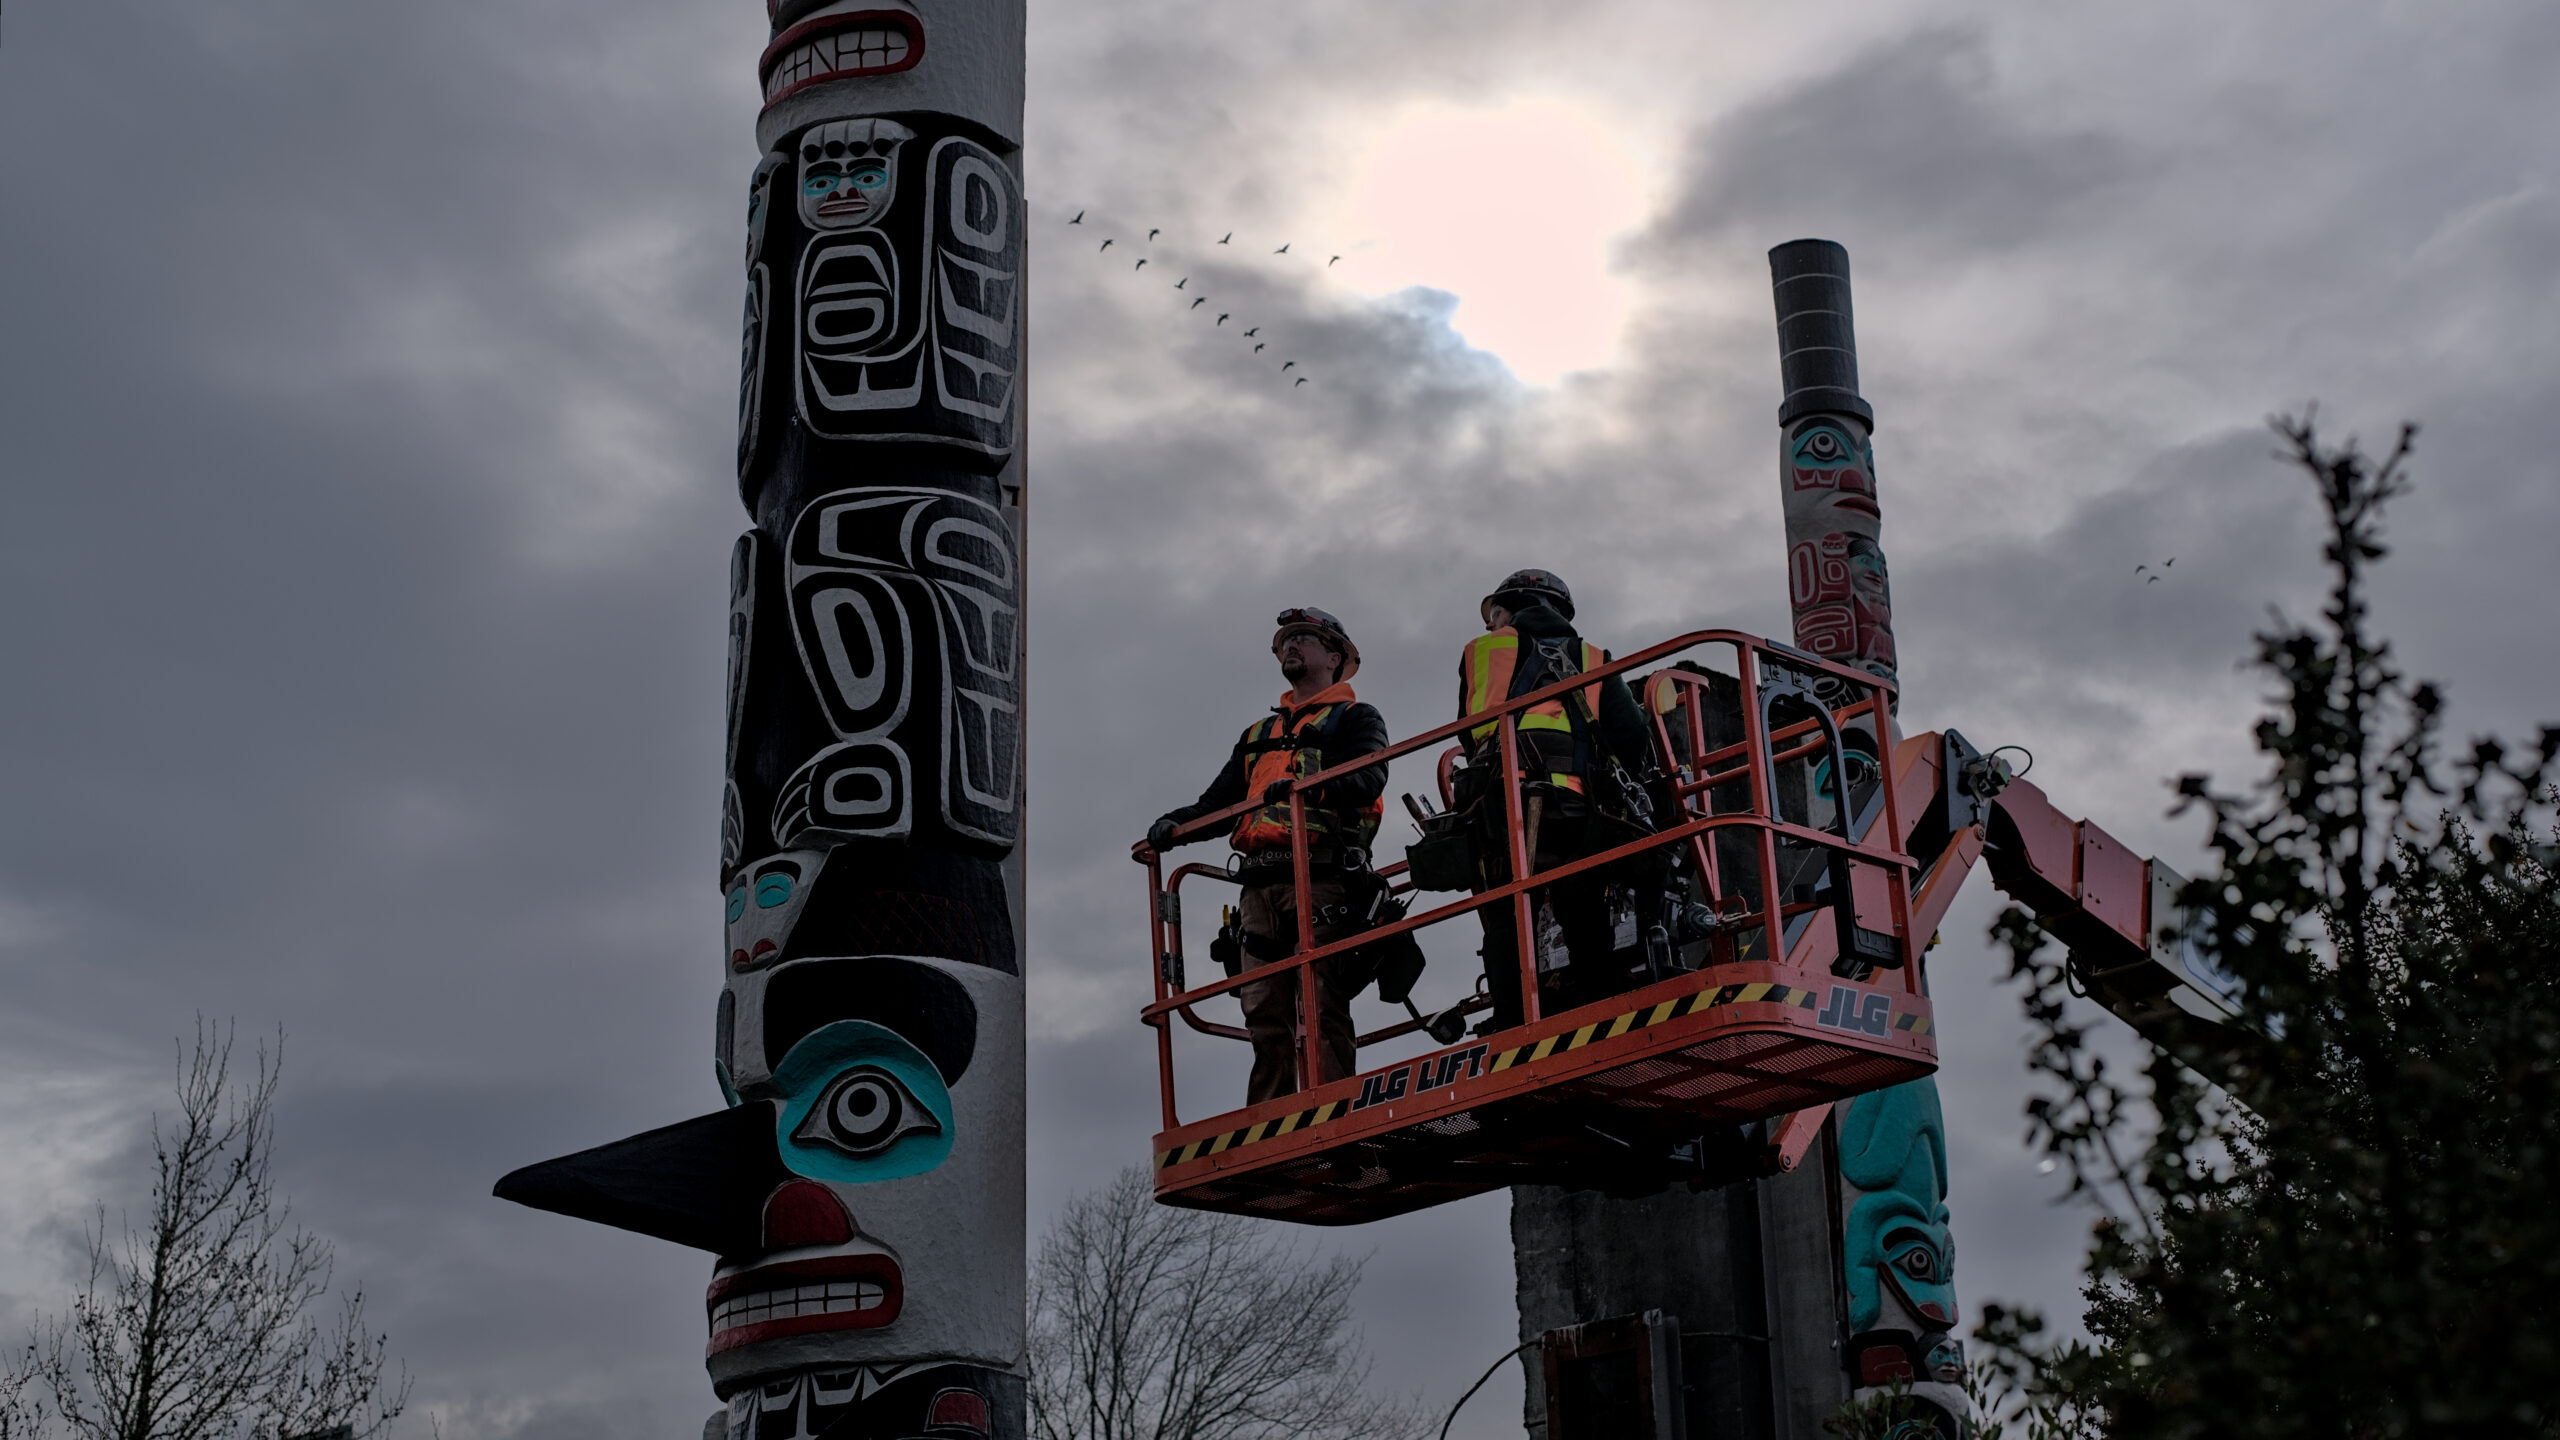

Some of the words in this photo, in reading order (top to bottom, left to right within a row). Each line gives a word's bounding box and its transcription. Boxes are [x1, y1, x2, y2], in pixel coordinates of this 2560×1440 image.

[1817, 985, 1891, 1038] JLG
[1351, 1065, 1411, 1112] JLG
[1415, 1043, 1489, 1094] LIFT
